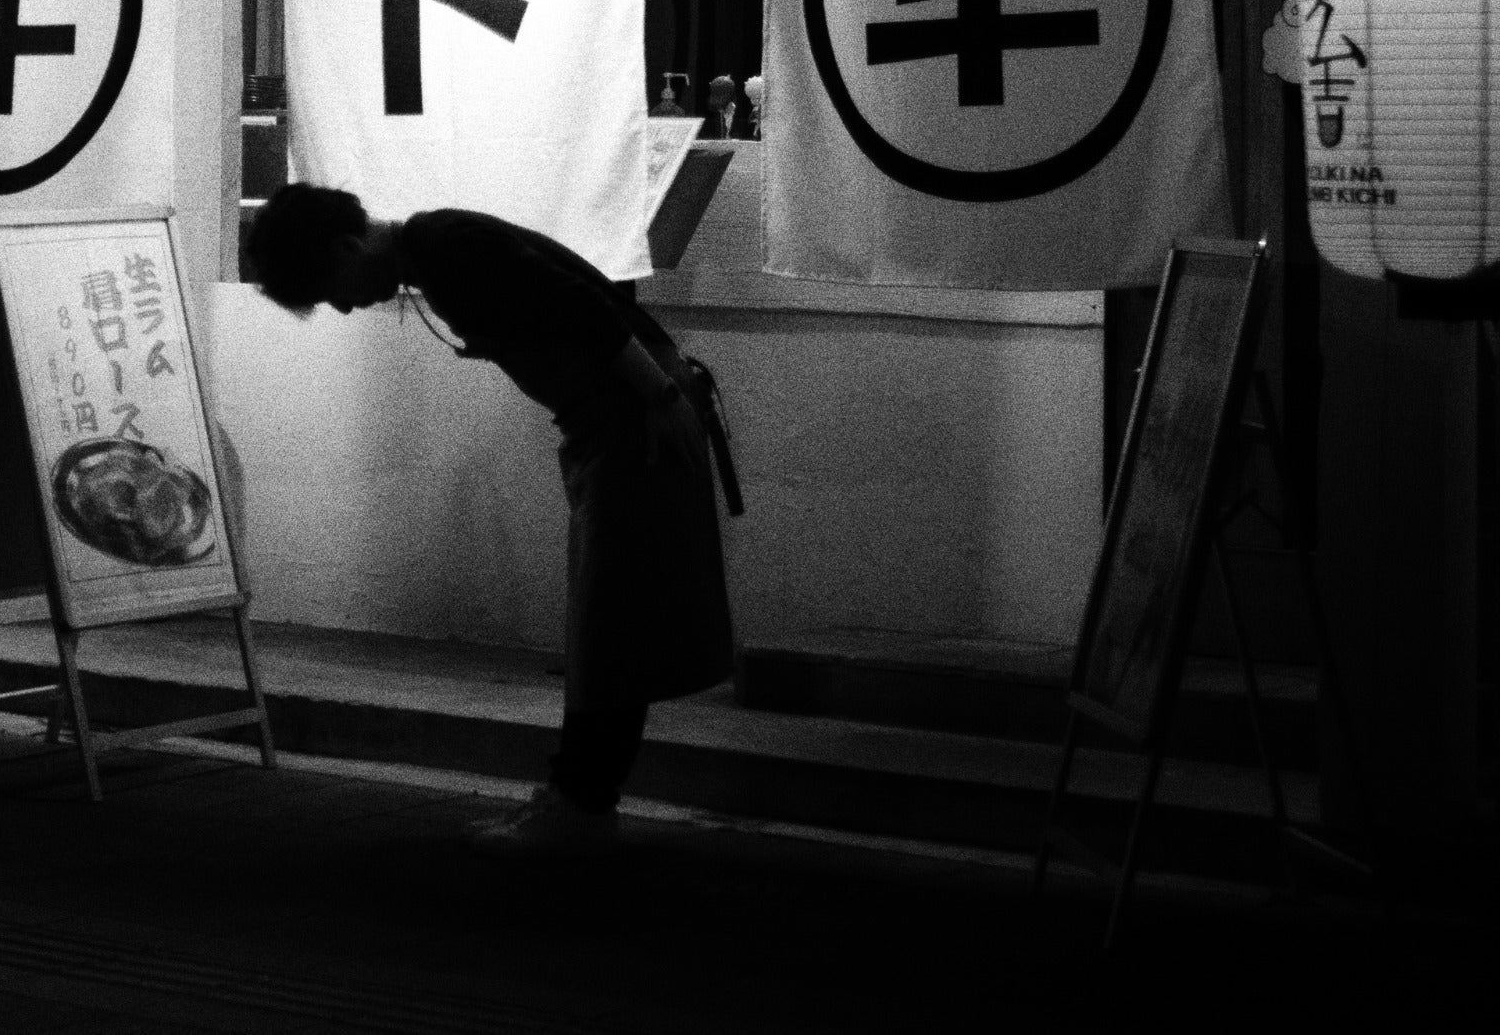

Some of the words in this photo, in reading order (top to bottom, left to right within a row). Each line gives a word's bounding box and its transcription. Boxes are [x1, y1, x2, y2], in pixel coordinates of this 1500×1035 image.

[80, 269, 145, 440] 肩ロース
[124, 252, 175, 379] 生ラム
